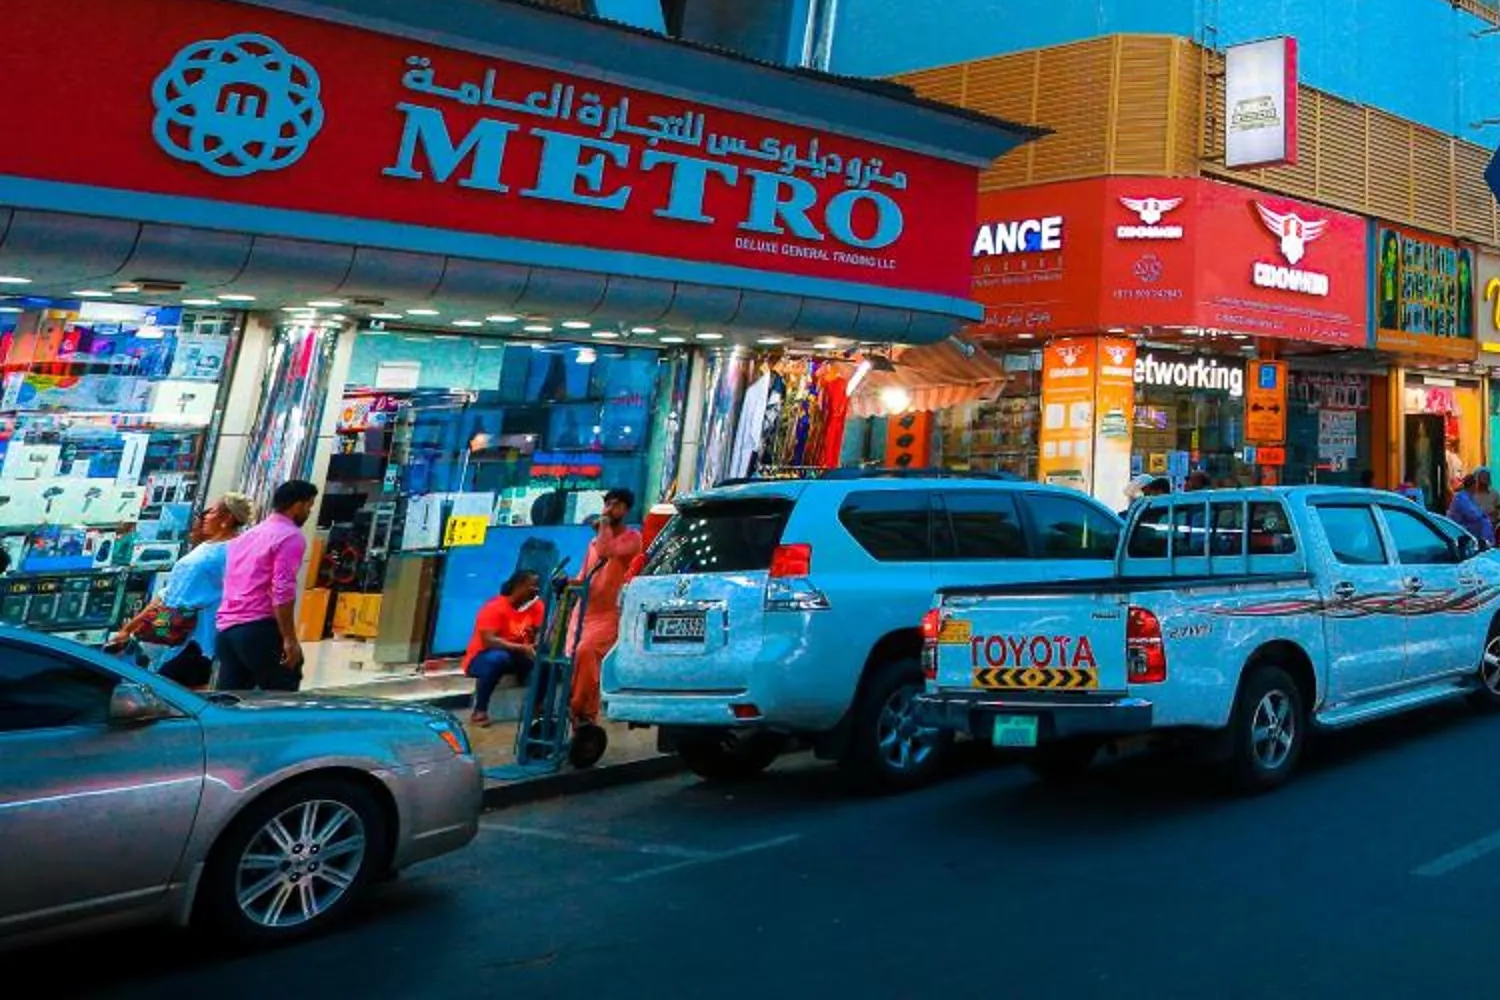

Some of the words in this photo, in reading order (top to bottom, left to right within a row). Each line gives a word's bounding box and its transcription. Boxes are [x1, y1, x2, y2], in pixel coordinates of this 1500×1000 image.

[402, 55, 575, 120] العامة
[381, 102, 904, 249] METRO
[845, 157, 908, 190] مترو
[735, 237, 779, 254] DELUXE
[781, 244, 831, 261] GENERAL
[833, 252, 877, 267] TRADING
[878, 259, 896, 270] LLC
[1133, 359, 1243, 396] etworking
[970, 635, 1097, 668] TOYOTA
